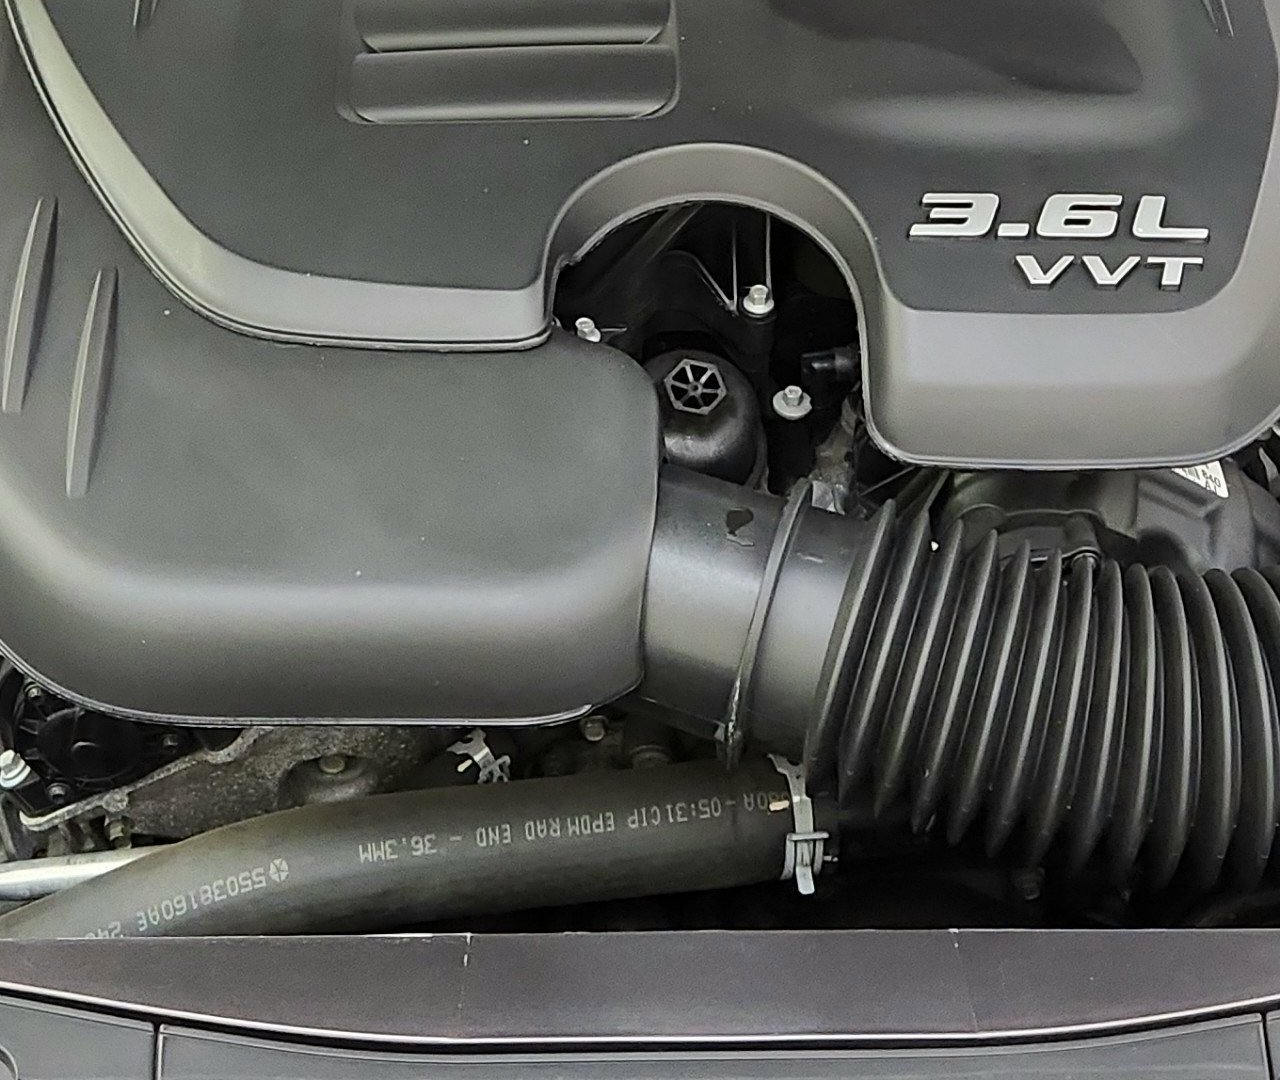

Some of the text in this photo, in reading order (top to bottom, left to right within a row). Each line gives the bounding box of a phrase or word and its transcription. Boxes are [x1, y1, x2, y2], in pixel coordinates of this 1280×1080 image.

[908, 191, 1210, 240] 3.6L
[1015, 254, 1205, 291] VVT
[476, 823, 511, 848] END
[524, 817, 561, 841] RAD
[567, 811, 615, 837] EPDM
[358, 833, 437, 864] 36.3MM
[136, 867, 267, 932] 55038160AE
